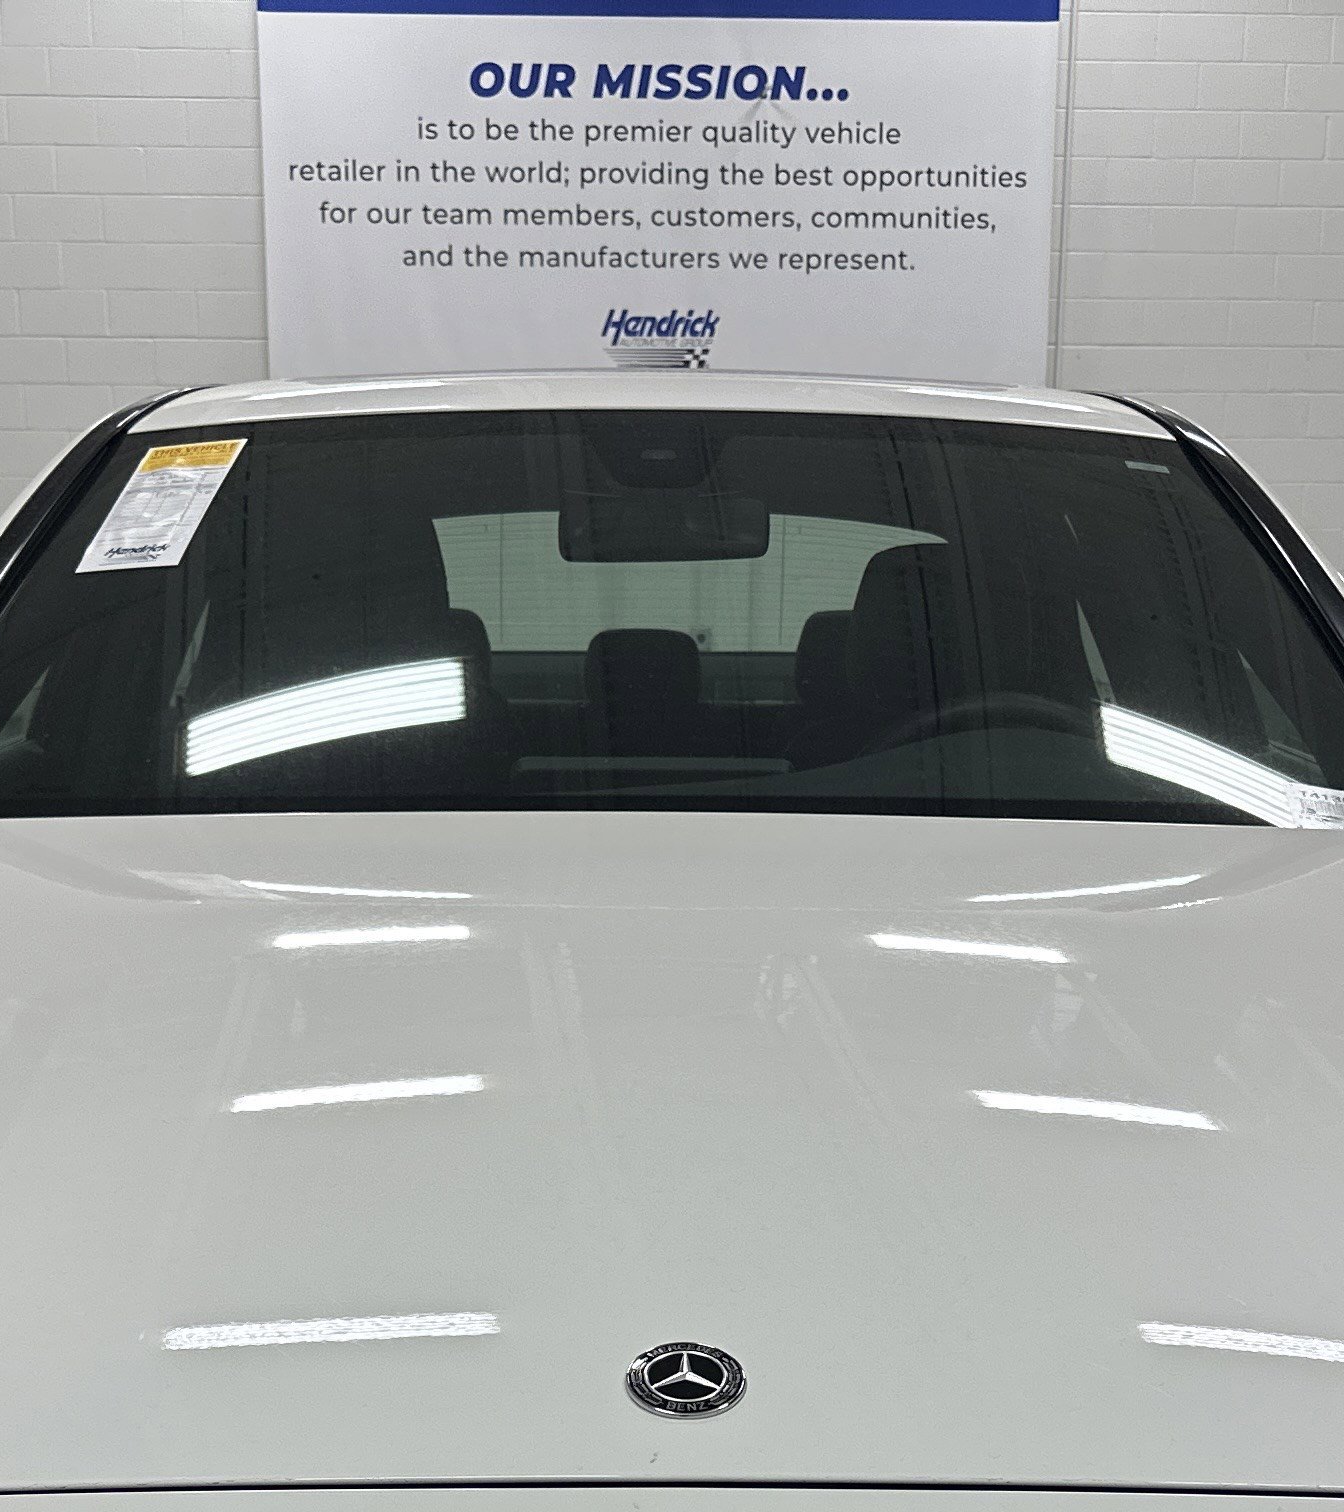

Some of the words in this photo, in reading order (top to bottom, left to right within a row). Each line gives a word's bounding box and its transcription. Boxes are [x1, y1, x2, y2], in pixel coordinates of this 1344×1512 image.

[470, 62, 576, 98] OUR
[593, 64, 849, 101] MISSION...
[418, 117, 438, 139] is
[447, 120, 475, 140] to
[486, 118, 519, 140] be
[529, 118, 574, 141] the
[585, 119, 692, 147] premier
[702, 120, 796, 149] quality
[805, 121, 901, 144] vehicle
[289, 159, 386, 181] retailer
[396, 159, 419, 182] in
[430, 160, 475, 183] the
[485, 161, 569, 187] world;
[580, 161, 708, 190] providing
[719, 162, 764, 185] the
[775, 163, 833, 186] best
[843, 165, 1027, 192] opportunities
[319, 201, 357, 224] for
[367, 208, 412, 224] our
[422, 205, 491, 225] team
[503, 204, 641, 230] members,
[651, 207, 801, 231] customers,
[811, 206, 995, 233] communities,
[403, 244, 453, 267] and
[463, 245, 508, 267] the
[520, 246, 719, 269] manufacturers
[729, 253, 768, 269] we
[779, 251, 914, 274] represent.
[601, 309, 720, 346] Hendrick
[666, 1402, 709, 1411] BENZ
